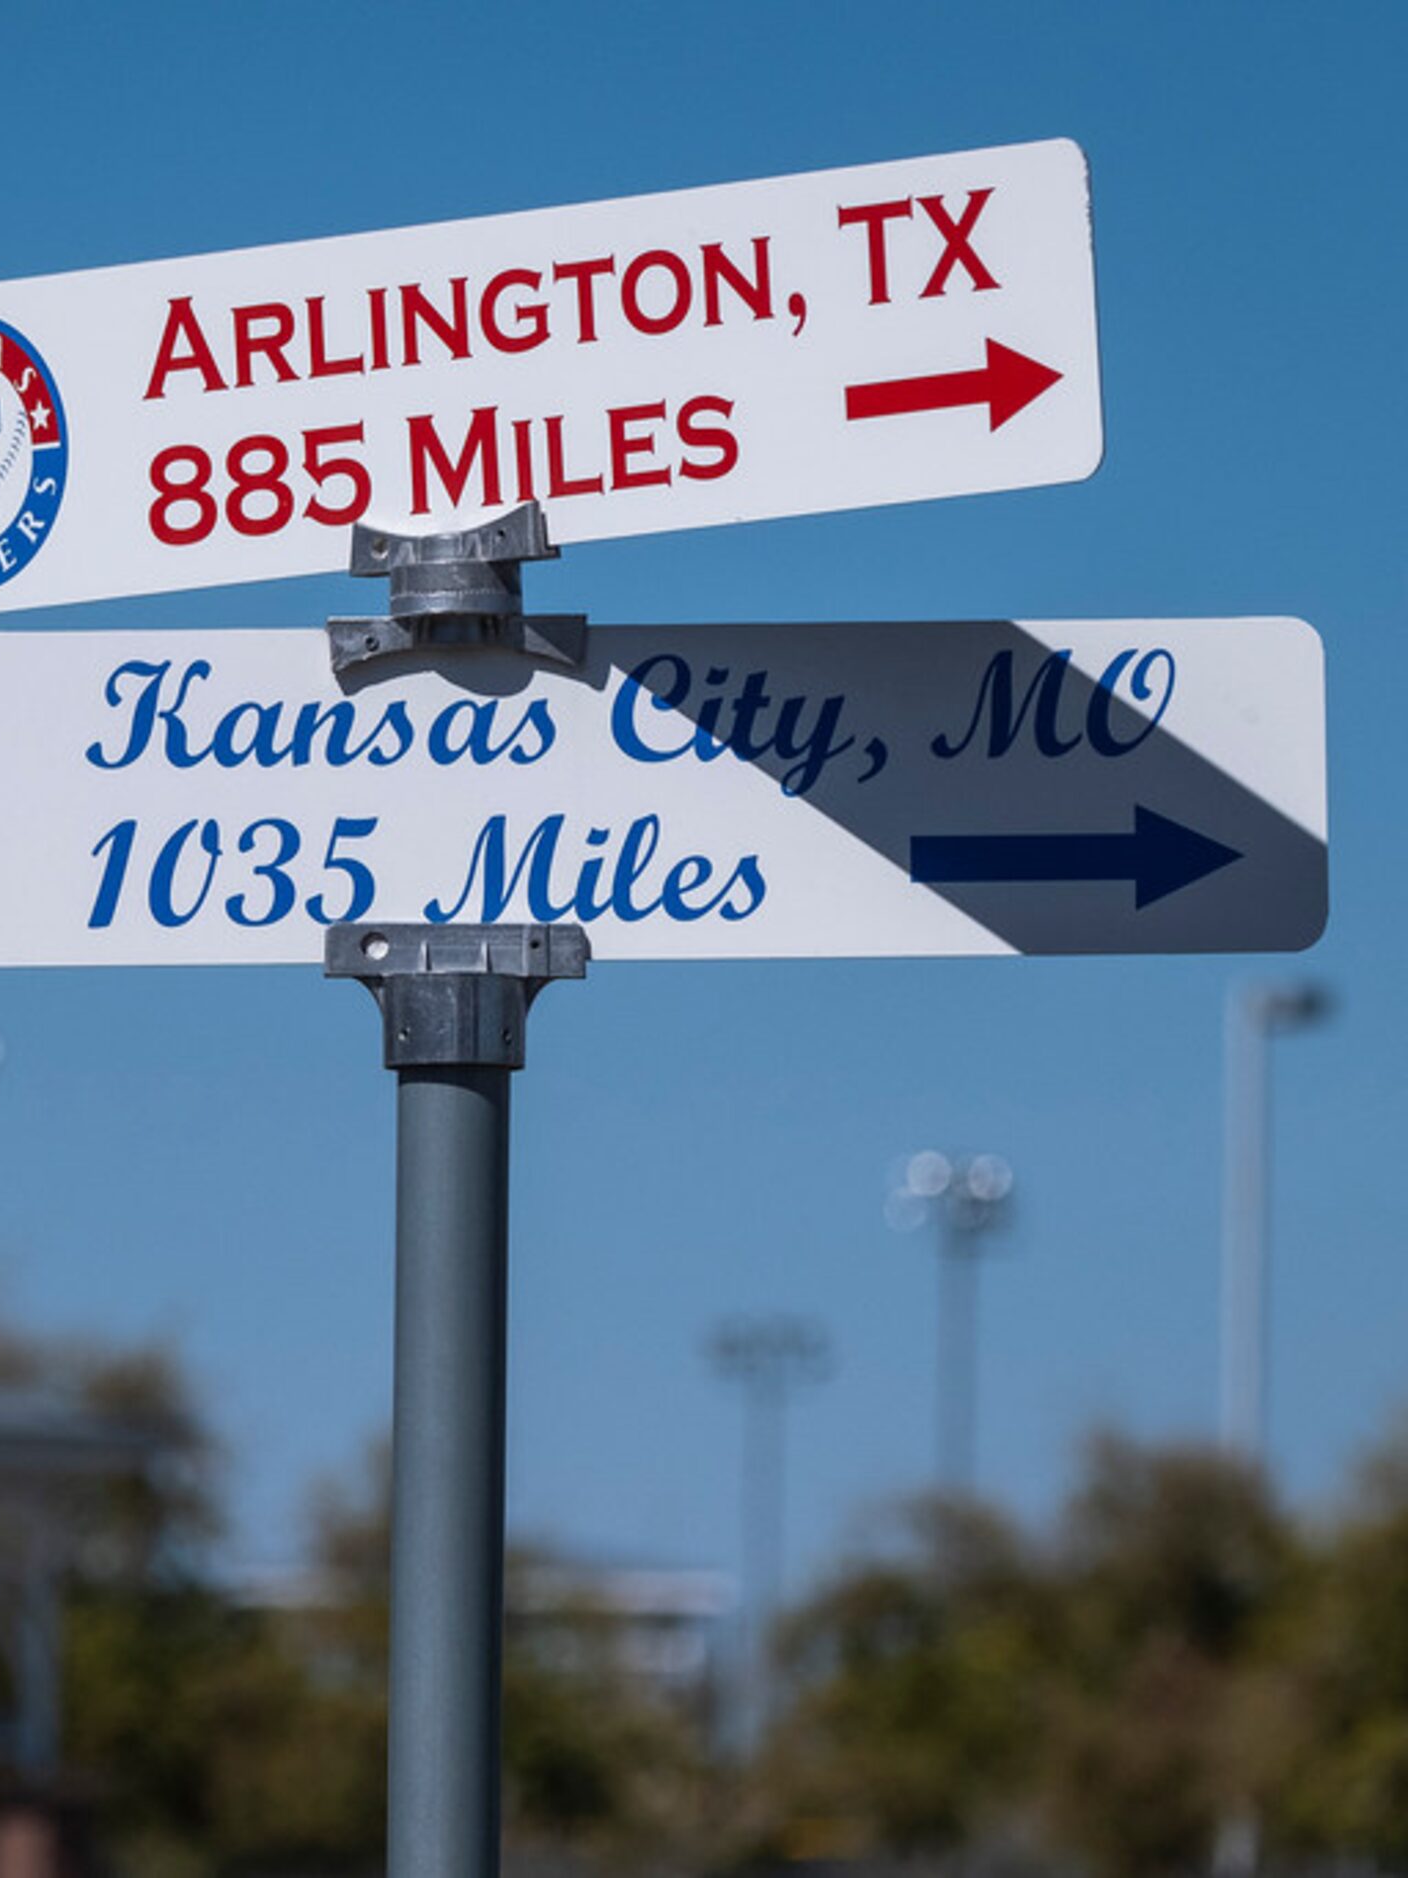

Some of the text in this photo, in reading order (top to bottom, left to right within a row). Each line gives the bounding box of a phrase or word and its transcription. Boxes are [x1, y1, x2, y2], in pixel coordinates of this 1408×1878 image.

[142, 187, 1002, 401] ARLINGTON, TX
[148, 395, 740, 546] 885 MILES
[85, 647, 1176, 798] Kansas City, MO
[87, 813, 767, 929] 1035 Miles
